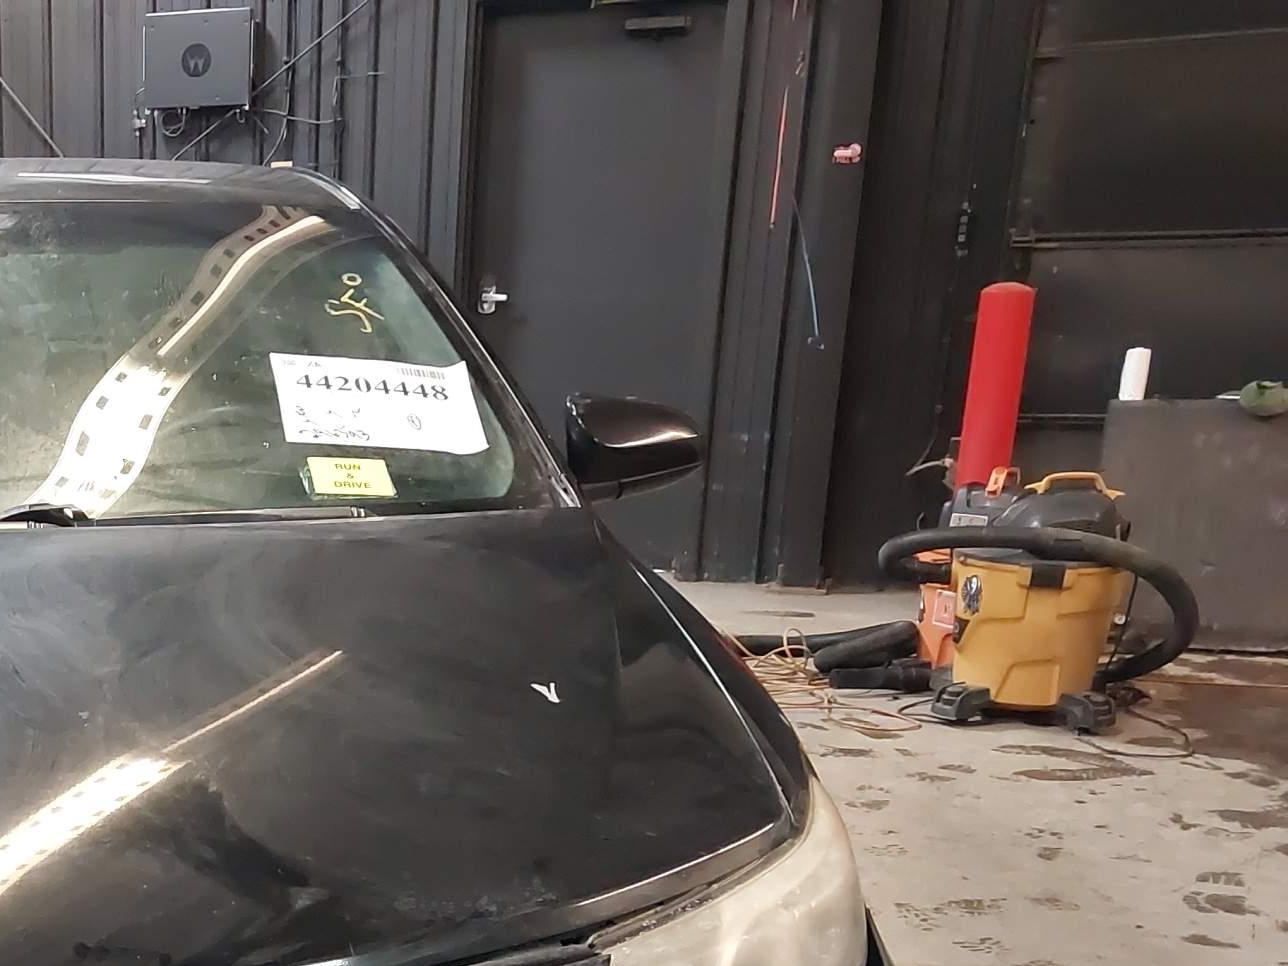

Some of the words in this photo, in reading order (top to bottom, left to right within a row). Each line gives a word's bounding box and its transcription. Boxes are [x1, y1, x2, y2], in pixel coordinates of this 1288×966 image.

[296, 373, 449, 401] 44204448
[334, 463, 361, 471] RUN
[334, 480, 373, 489] DRIVE
